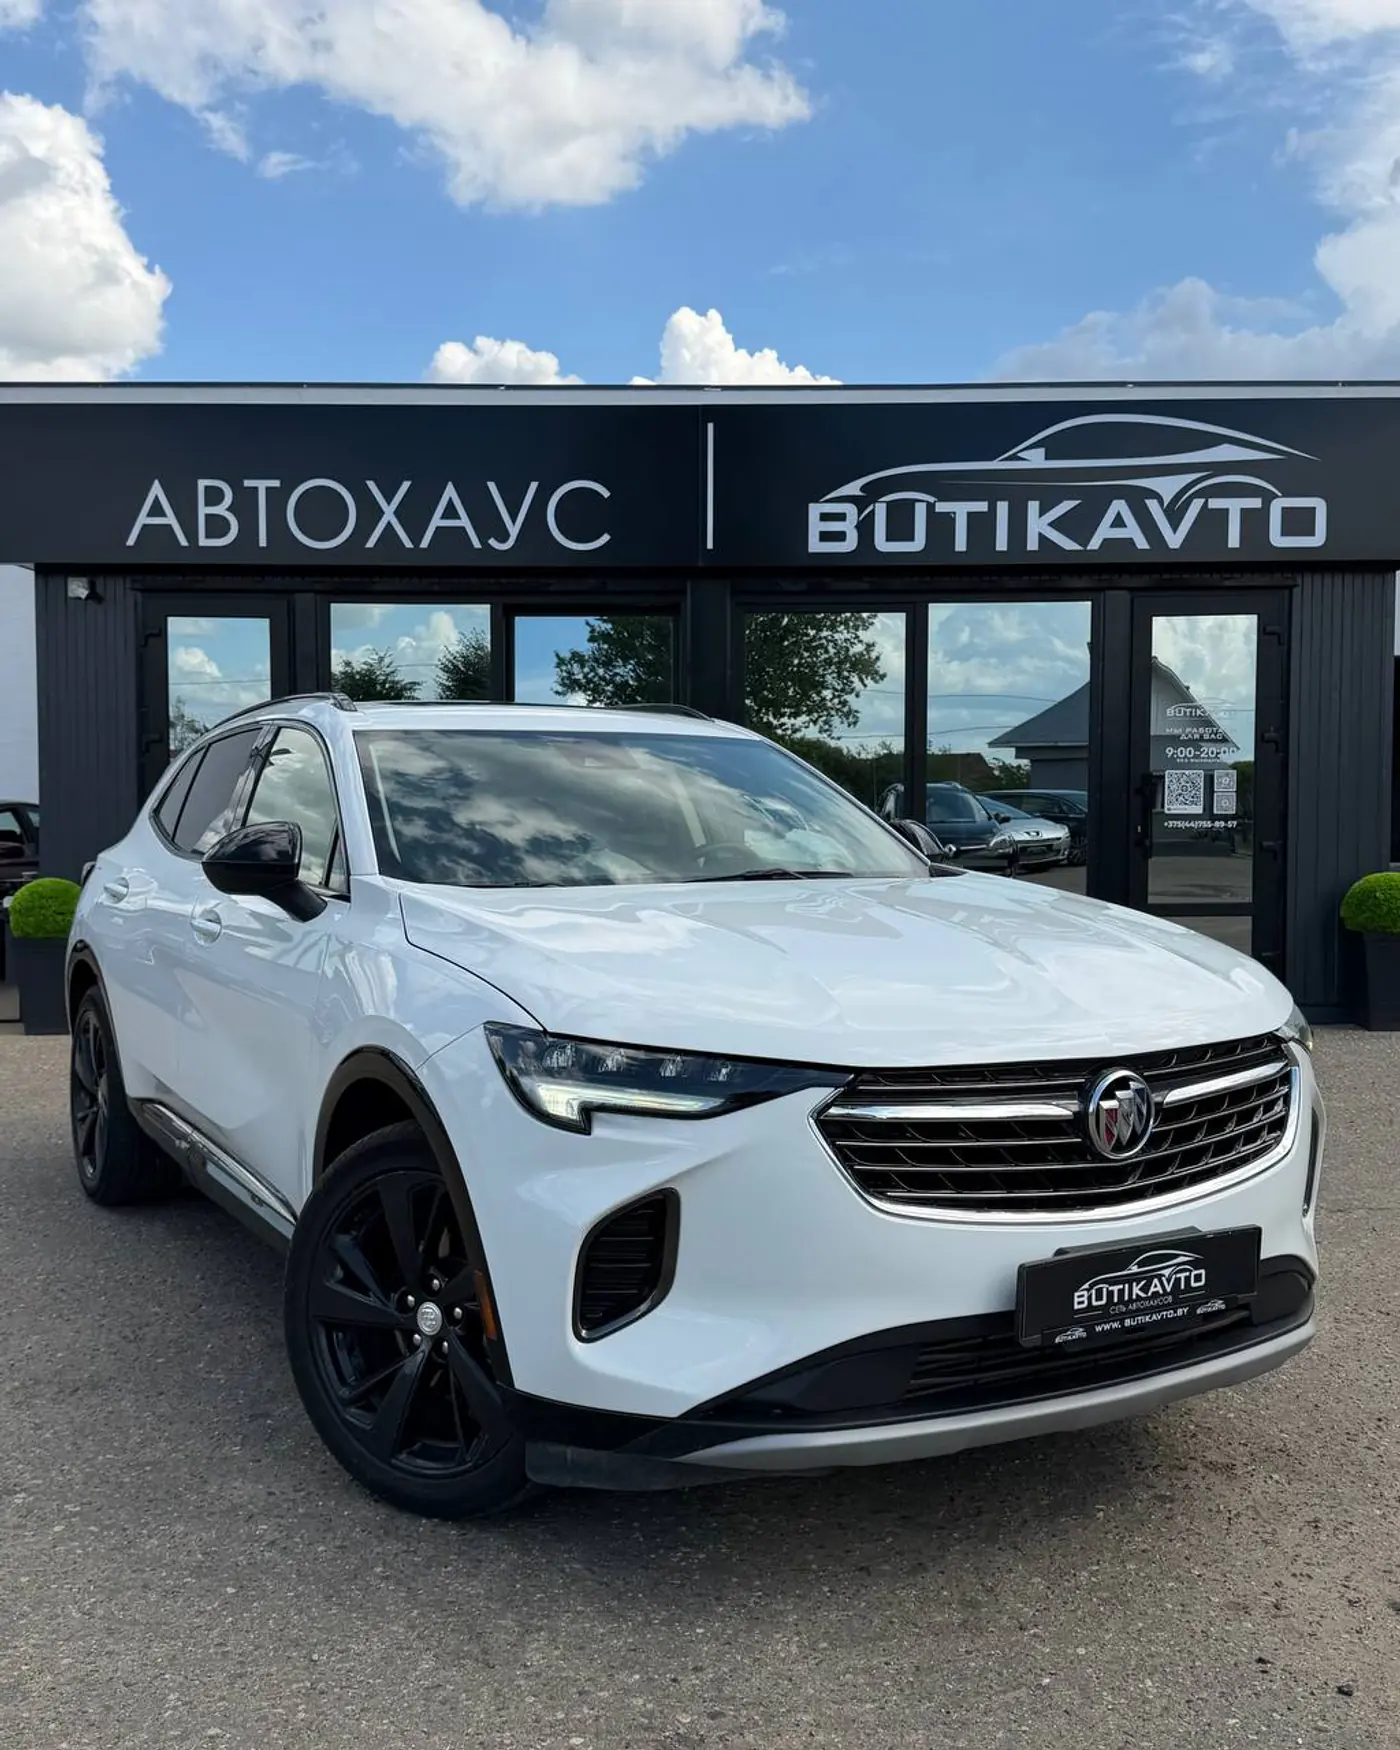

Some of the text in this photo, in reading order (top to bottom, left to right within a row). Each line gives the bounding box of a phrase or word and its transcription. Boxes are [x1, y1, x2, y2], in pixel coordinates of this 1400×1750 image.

[126, 478, 612, 551] АВТОХАУС
[808, 497, 1328, 553] BUTIKAVTO
[1074, 1269, 1206, 1310] BUTIKAVTO
[1094, 1306, 1190, 1332] WWW. BUTIKAVTO.BY
